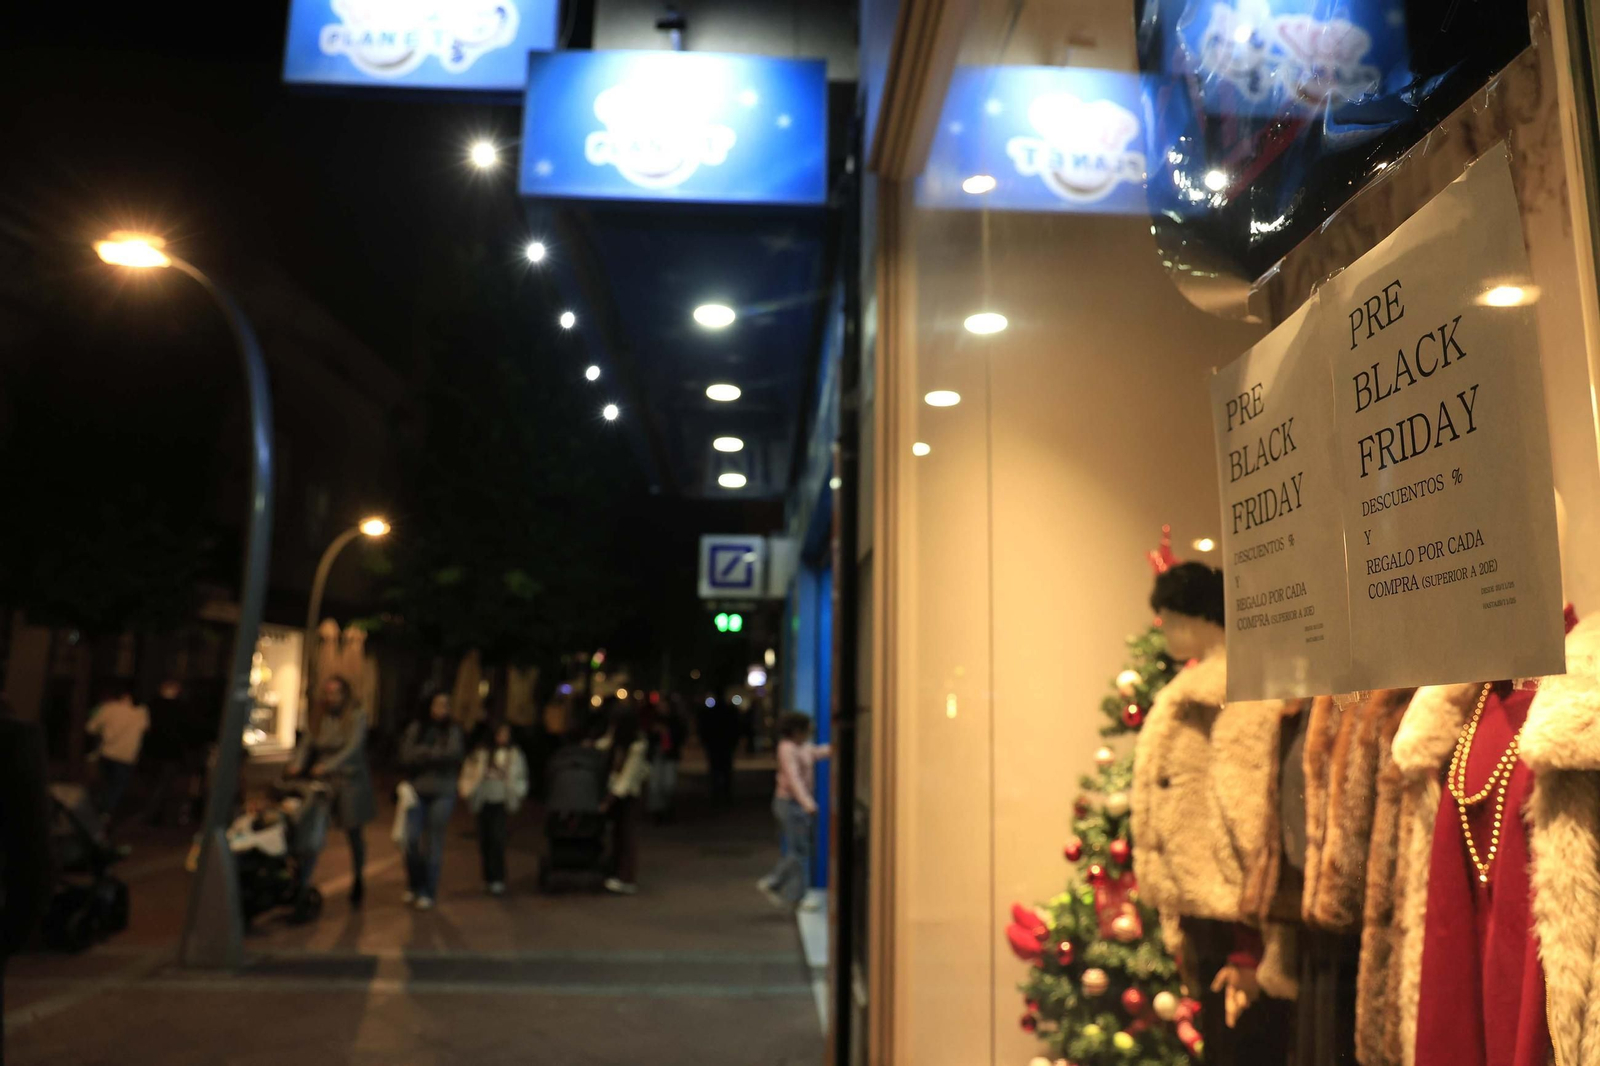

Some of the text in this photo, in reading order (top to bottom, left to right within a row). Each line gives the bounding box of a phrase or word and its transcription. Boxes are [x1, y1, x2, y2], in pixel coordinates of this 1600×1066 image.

[1349, 279, 1405, 350] PRE
[1353, 315, 1467, 413] BLACK
[1226, 382, 1264, 432] PRE
[1358, 384, 1479, 478] FRIDAY
[1229, 417, 1297, 483] BLACK
[1231, 472, 1303, 535] FRIDAY
[1362, 467, 1463, 517] DESCUENTOS %
[1234, 536, 1285, 566] DESCUENTOS
[1364, 529, 1371, 546] Y
[1366, 529, 1485, 575] REGALO POR CADA
[1236, 582, 1307, 612] REGALO POR CADA
[1368, 559, 1498, 600] COMPRA (SUPERIOR A 20E)
[1236, 613, 1270, 631] COMPRA
